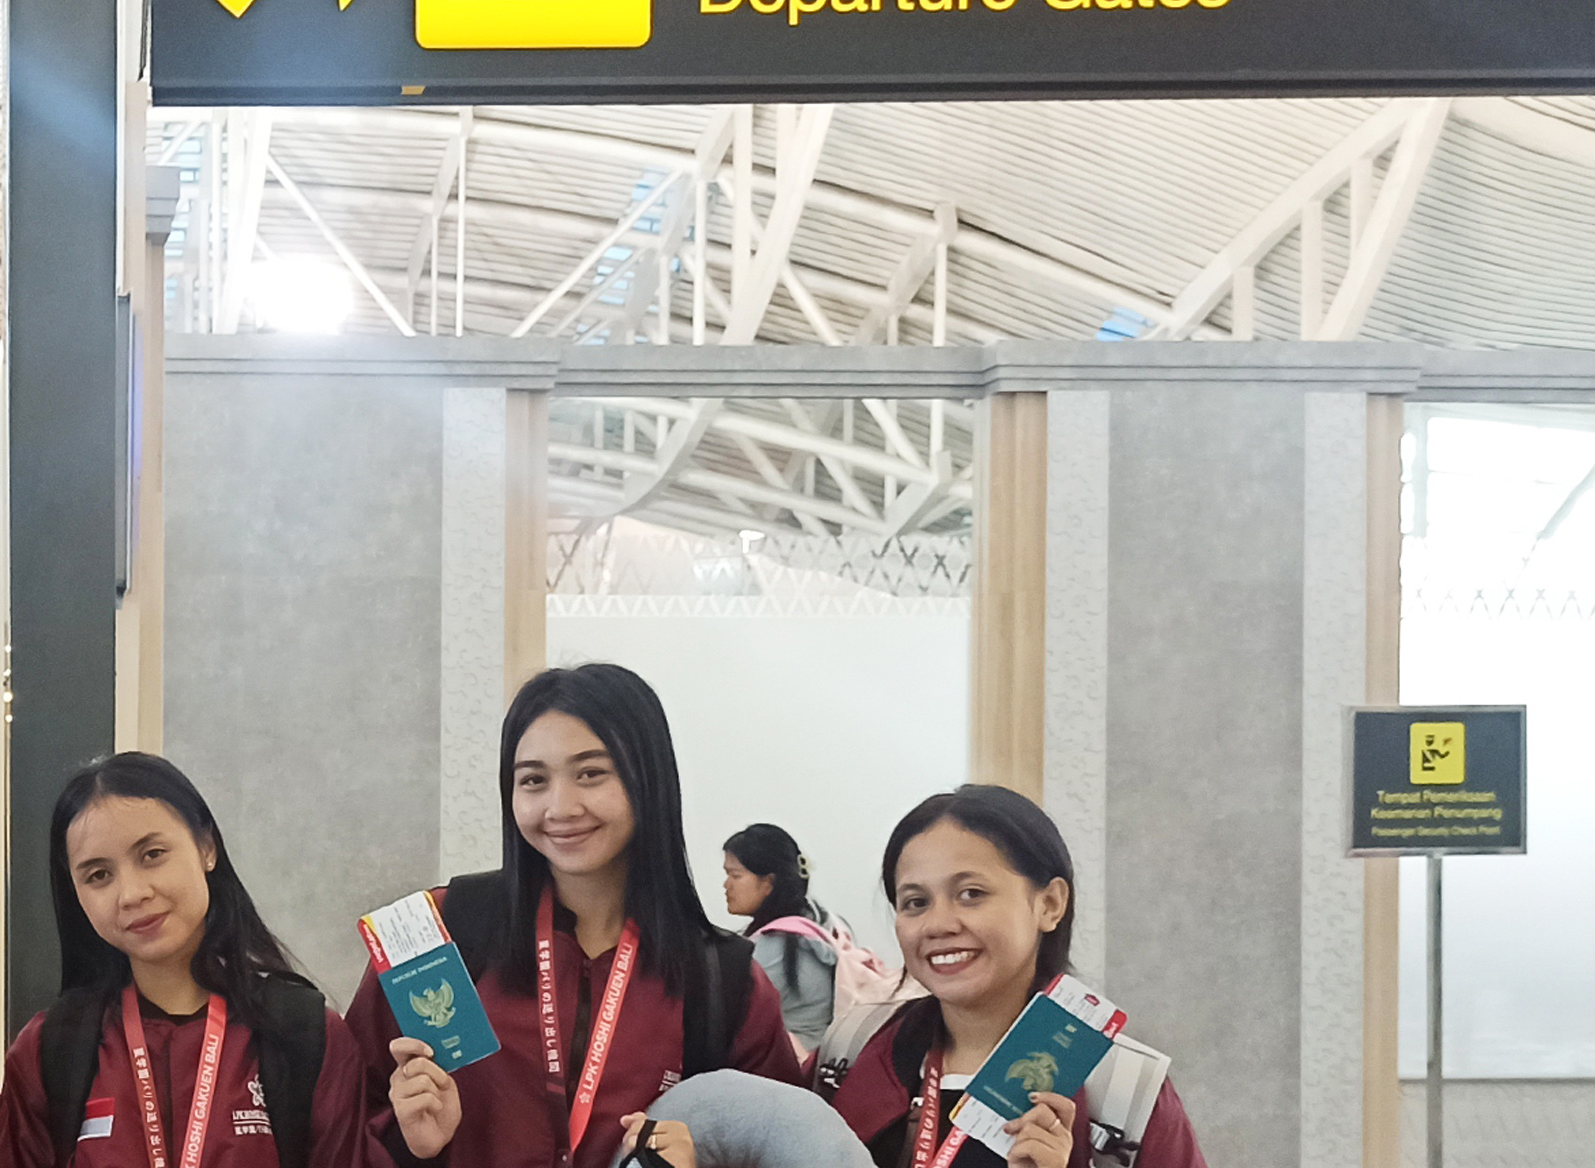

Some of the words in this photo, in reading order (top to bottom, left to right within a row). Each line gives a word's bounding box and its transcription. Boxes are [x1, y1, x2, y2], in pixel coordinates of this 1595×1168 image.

[582, 1063, 599, 1091] LPK
[591, 1022, 612, 1064] HOSHI
[602, 971, 626, 1022] GAKUEN
[617, 943, 633, 972] BALI
[186, 1121, 204, 1163] HOSHI
[195, 1066, 214, 1120] GAKUEN
[205, 1034, 220, 1065] BALI
